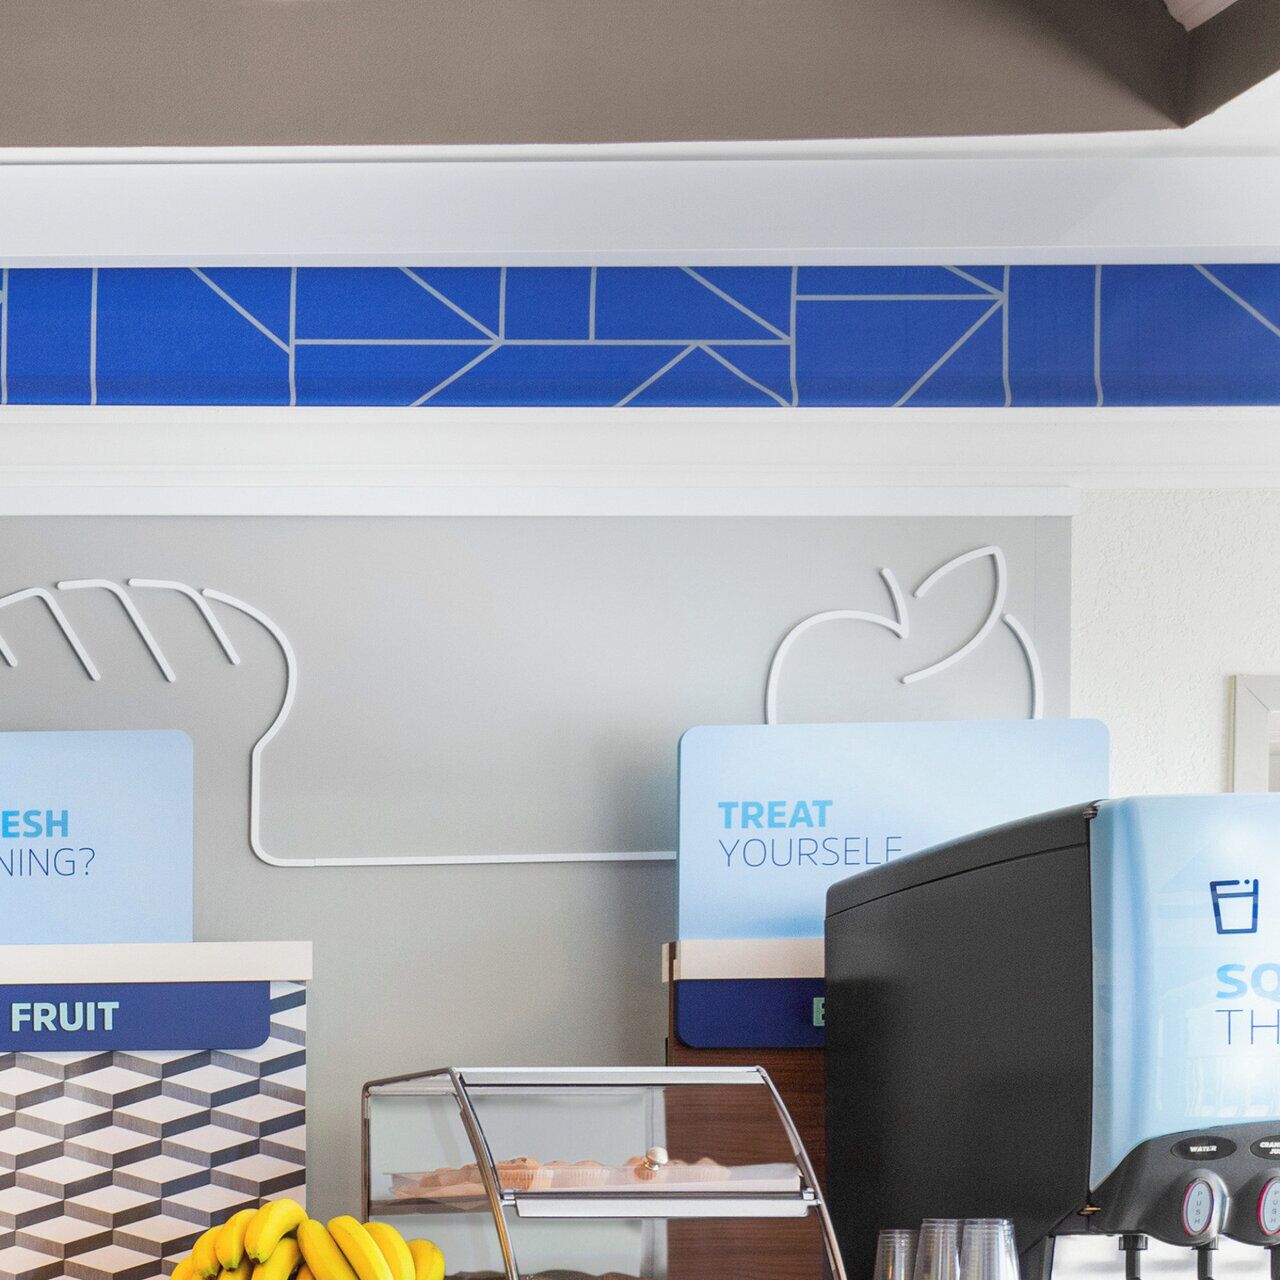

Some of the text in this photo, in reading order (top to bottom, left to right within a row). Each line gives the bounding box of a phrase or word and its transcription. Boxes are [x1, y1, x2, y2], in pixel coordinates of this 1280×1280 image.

[718, 799, 833, 829] TREAT
[718, 836, 903, 868] YOURSELF
[10, 1001, 120, 1033] FRUIT
[1189, 1144, 1218, 1153] WATER
